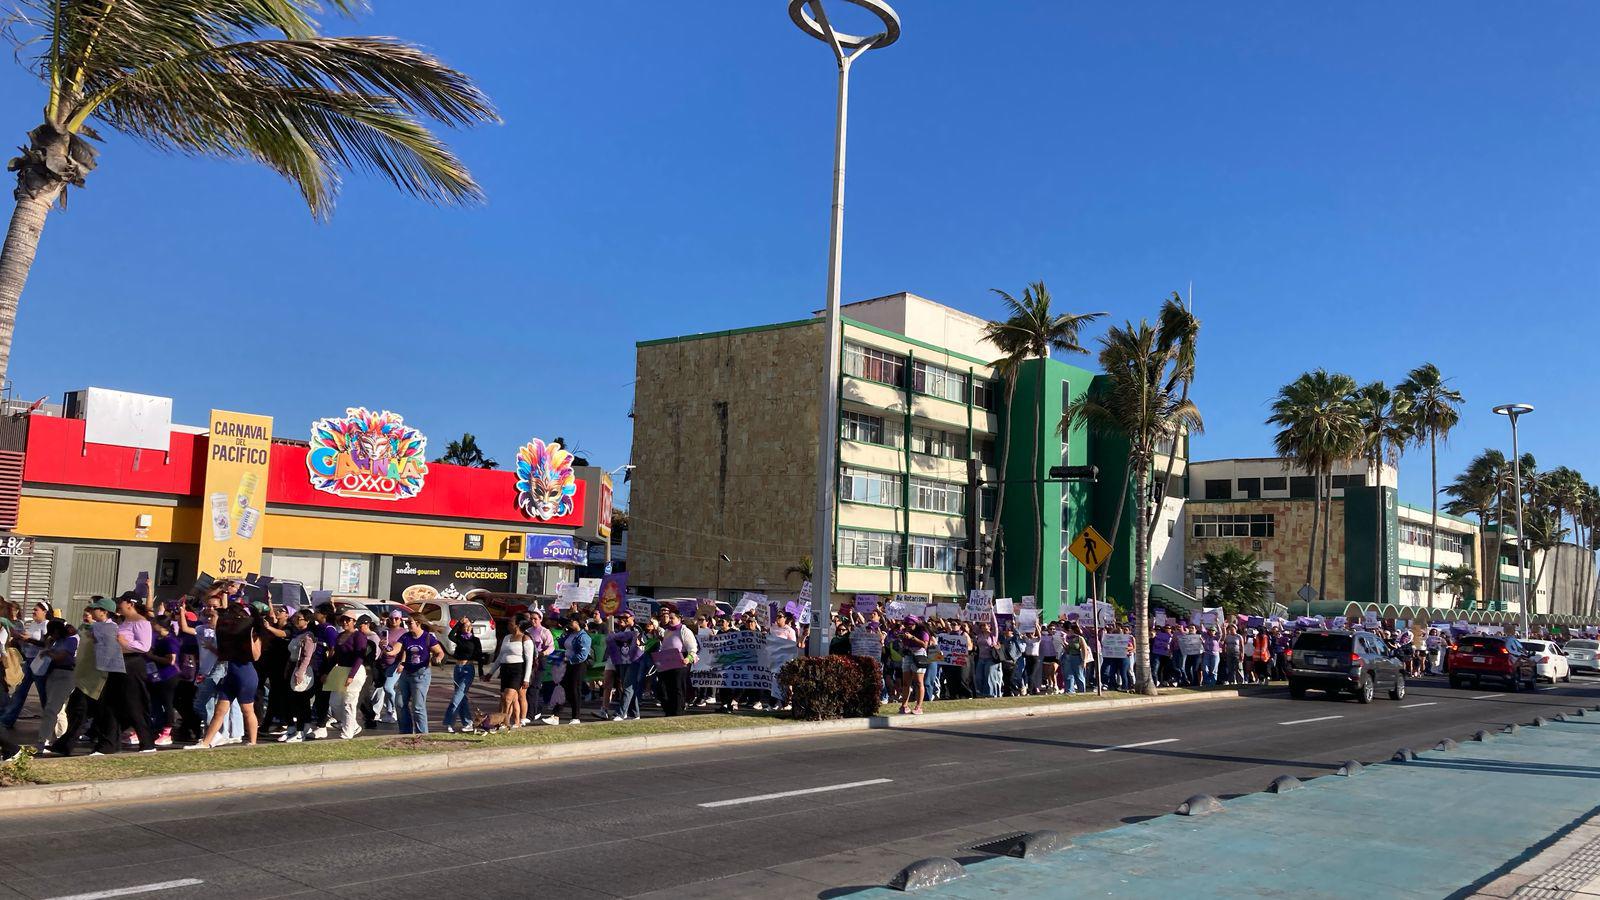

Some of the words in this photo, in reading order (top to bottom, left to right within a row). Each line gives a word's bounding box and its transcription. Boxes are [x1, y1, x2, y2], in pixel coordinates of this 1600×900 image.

[214, 421, 269, 441] CARNAVAL
[235, 437, 246, 446] DEL
[212, 444, 267, 465] PACIFICO
[343, 473, 396, 492] OXXO
[219, 557, 243, 574] $102
[416, 568, 440, 576] gourmet
[455, 571, 508, 580] CONOCEDORES
[738, 637, 753, 645] NO
